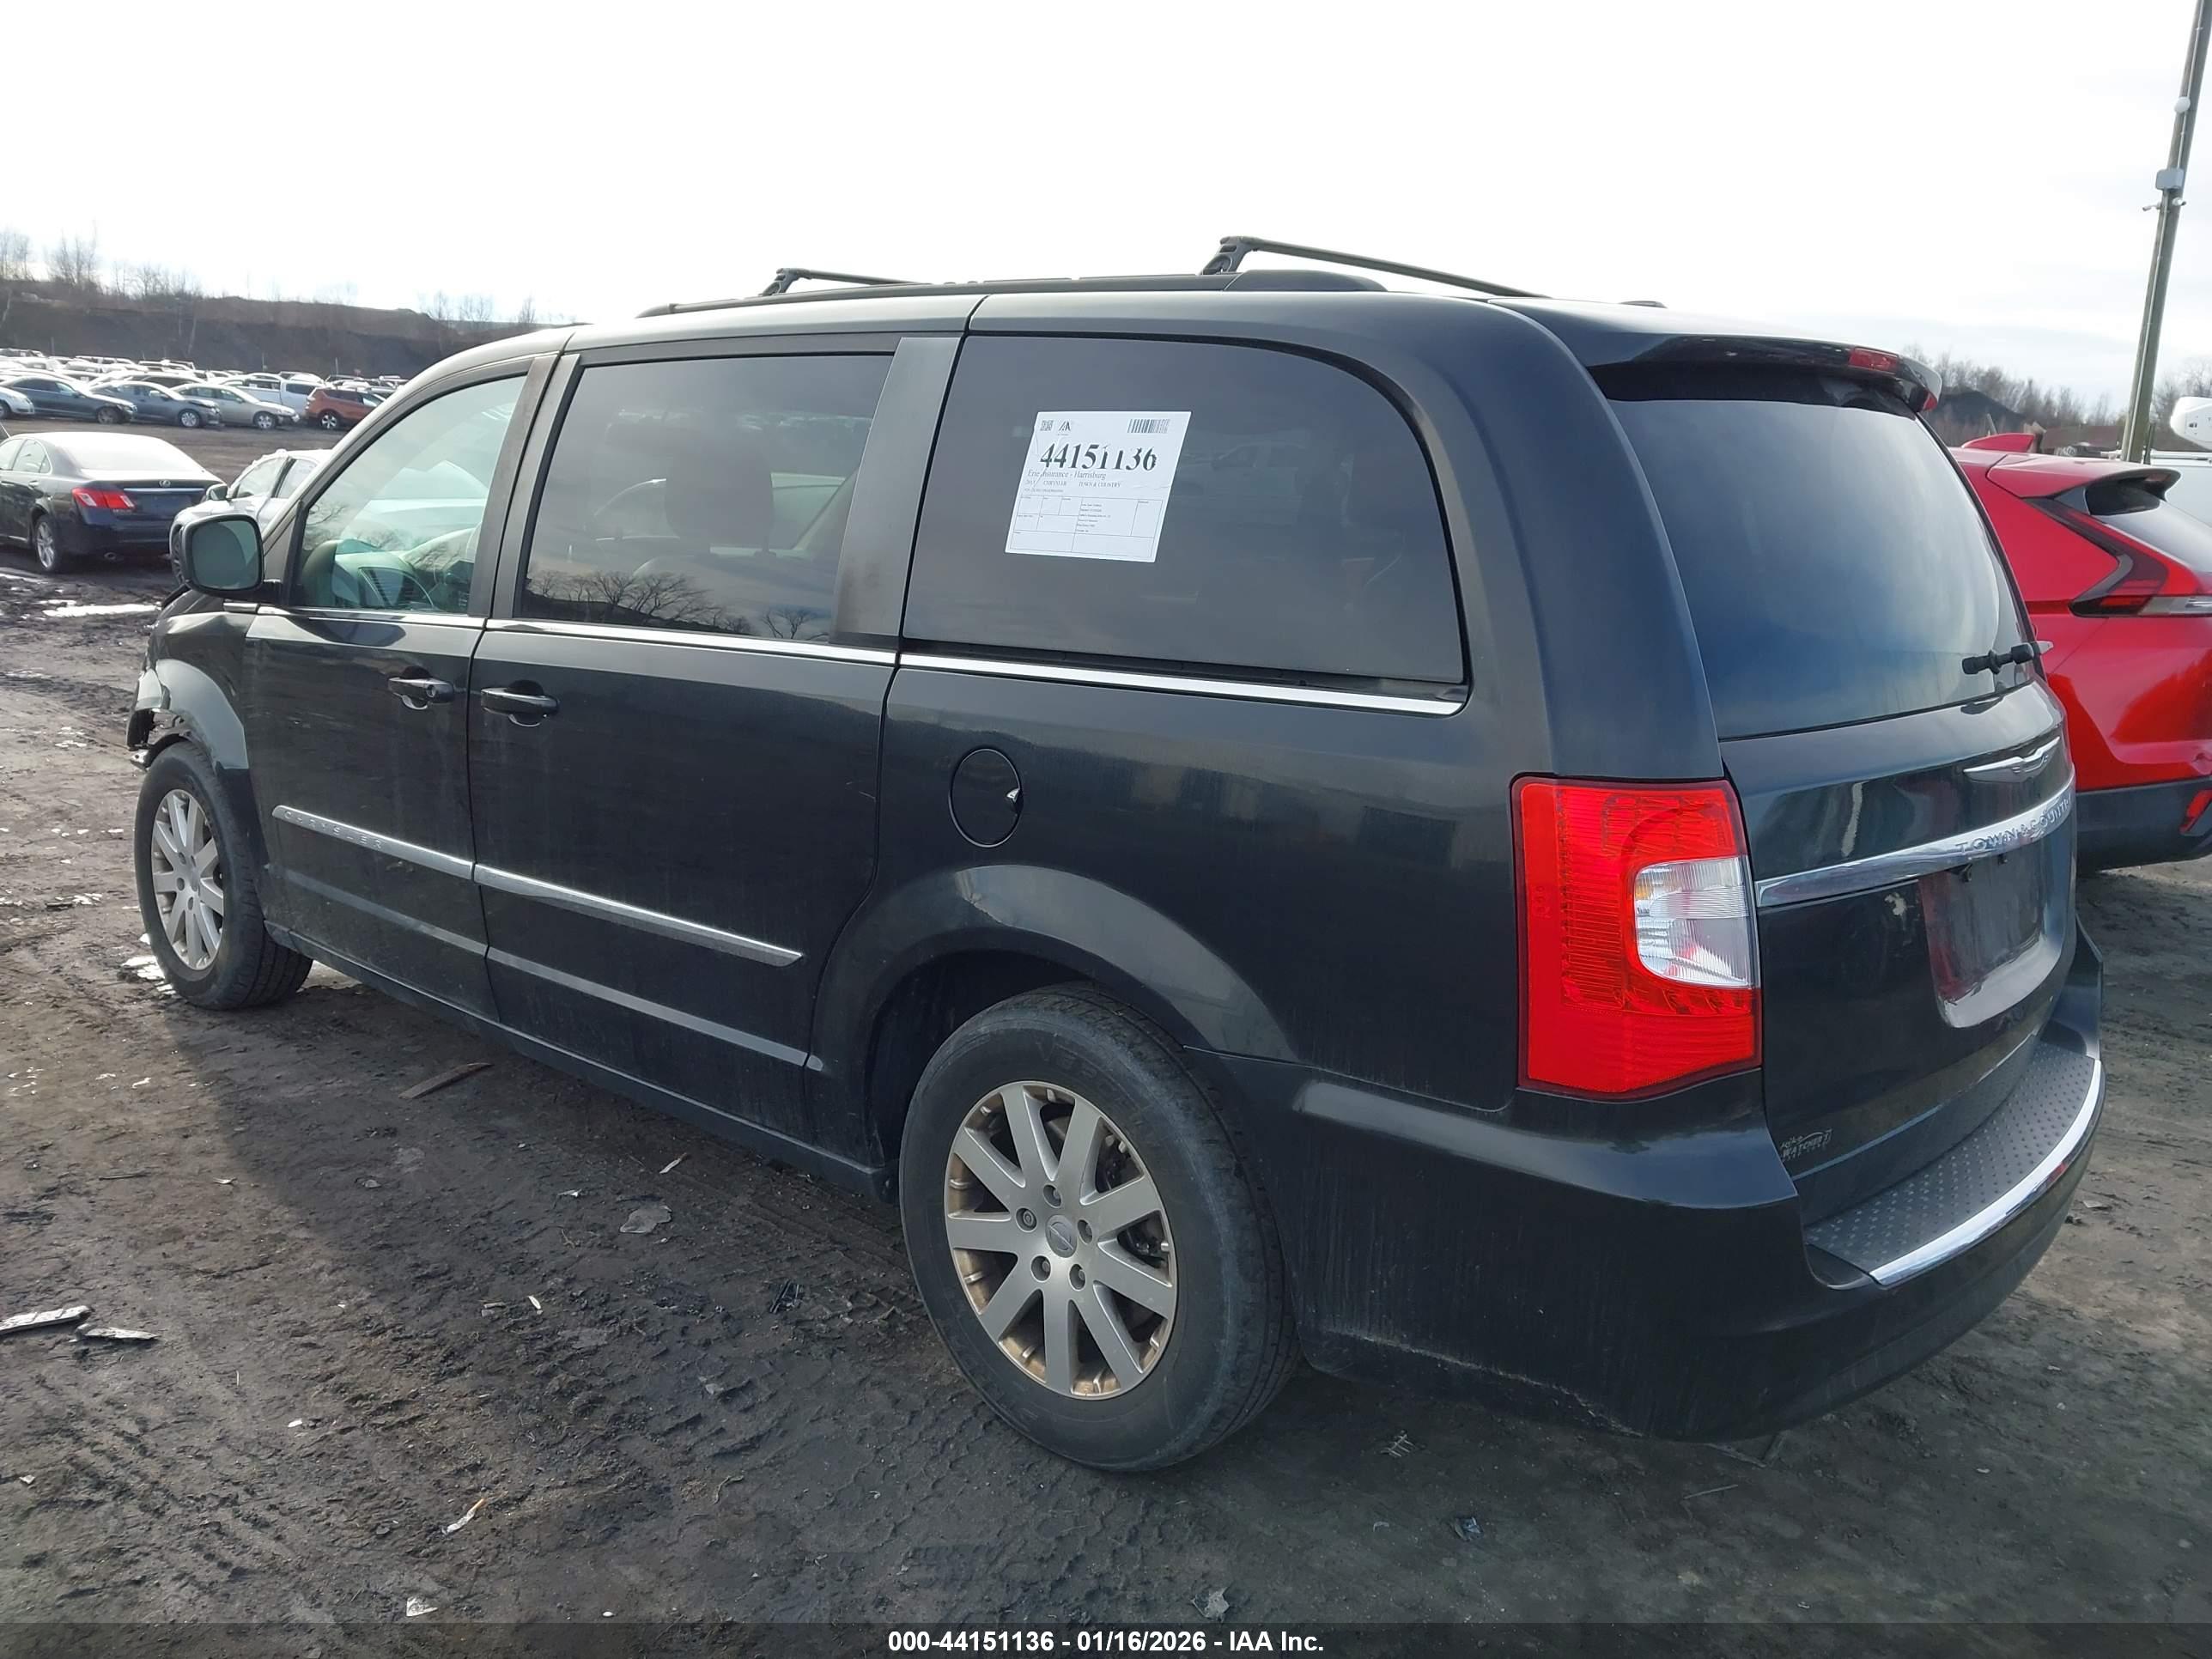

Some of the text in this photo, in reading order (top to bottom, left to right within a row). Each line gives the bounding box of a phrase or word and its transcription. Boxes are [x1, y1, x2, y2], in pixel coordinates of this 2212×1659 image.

[1040, 442, 1158, 471] 44151136
[1027, 469, 1041, 477] Erie
[1073, 471, 1107, 480] Harrisburg
[1955, 827, 2019, 853] TOWN
